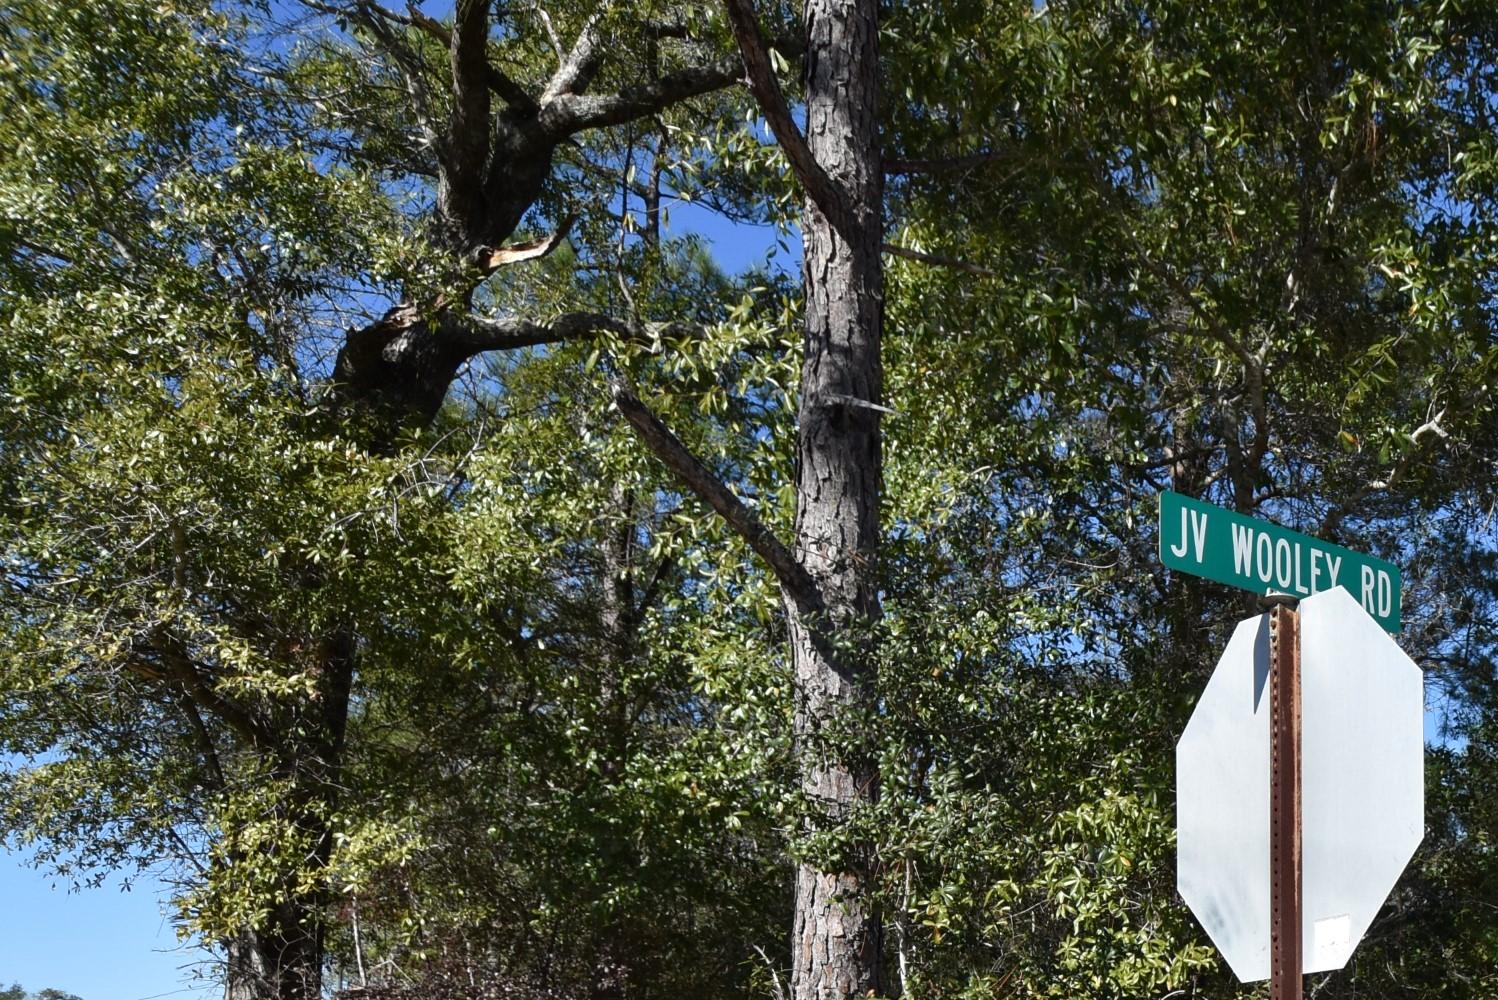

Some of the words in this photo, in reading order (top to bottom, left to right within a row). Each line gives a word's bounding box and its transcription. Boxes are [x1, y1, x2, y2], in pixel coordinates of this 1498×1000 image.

[1170, 506, 1208, 563] JV
[1231, 522, 1342, 596] WOOLEY
[1361, 564, 1392, 618] RD
